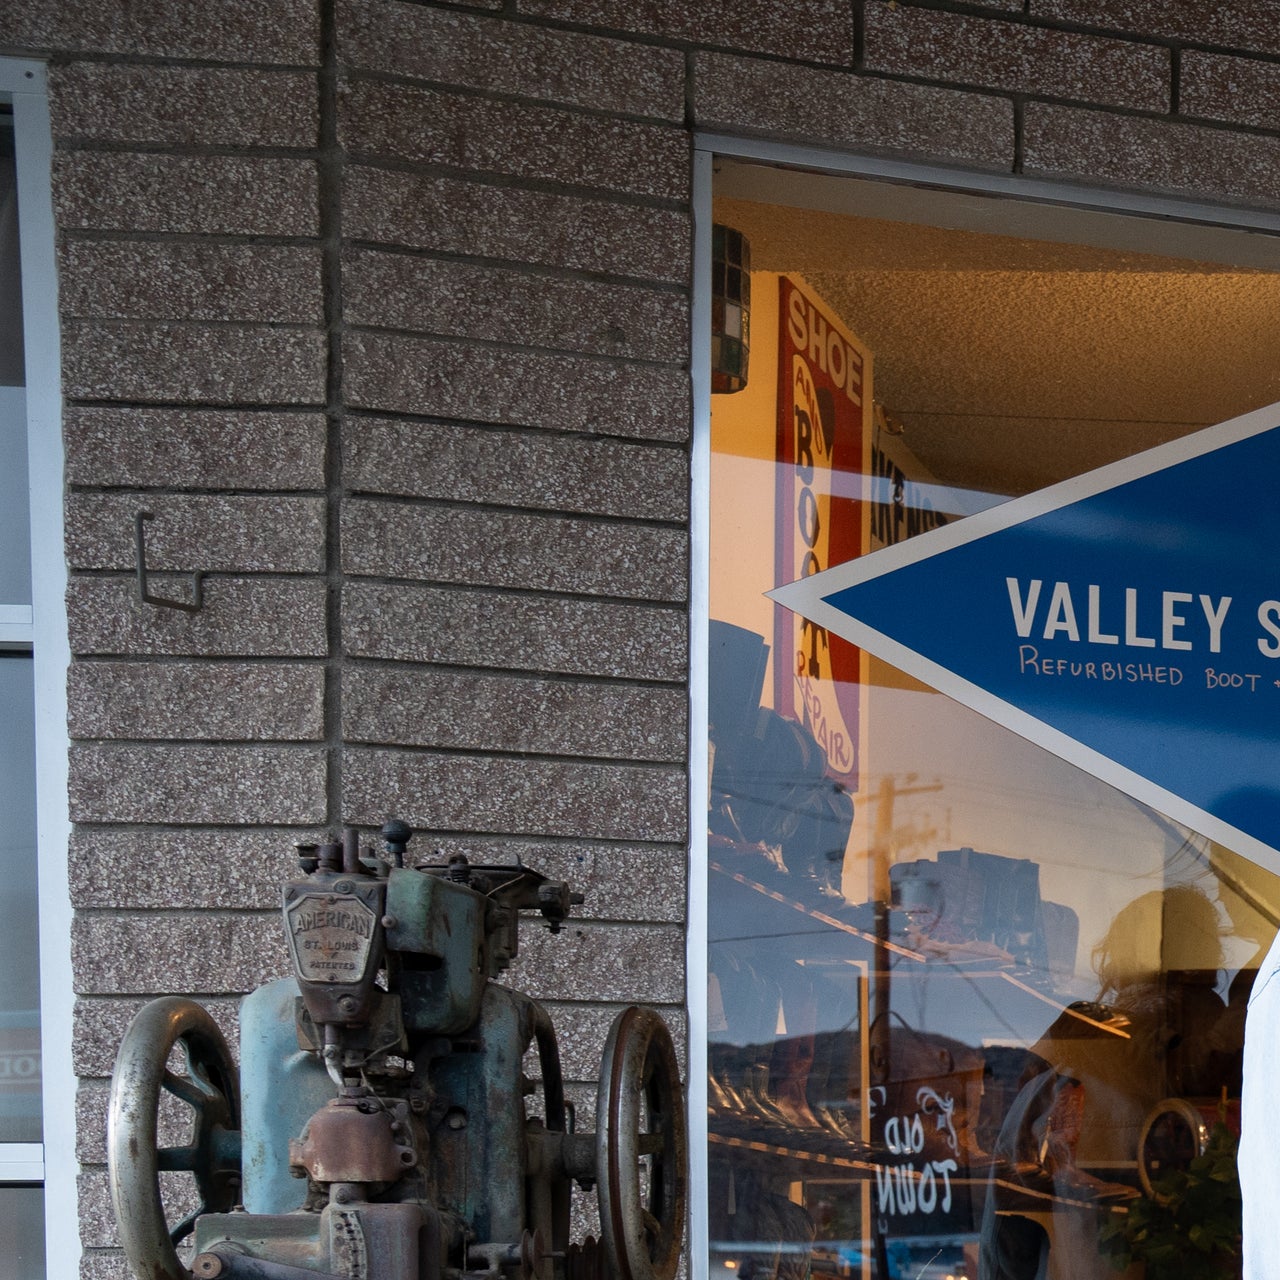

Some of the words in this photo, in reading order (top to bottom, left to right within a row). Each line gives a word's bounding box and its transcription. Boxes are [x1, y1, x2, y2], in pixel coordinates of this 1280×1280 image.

[788, 288, 863, 408] SHOE
[795, 364, 824, 456] AND
[1006, 577, 1232, 653] VALLEY
[1019, 644, 1184, 686] REFURBISHED
[1205, 668, 1262, 692] BOOT
[796, 650, 850, 768] REPAIR
[294, 910, 371, 940] AMERICAN
[328, 940, 359, 951] LOUIS
